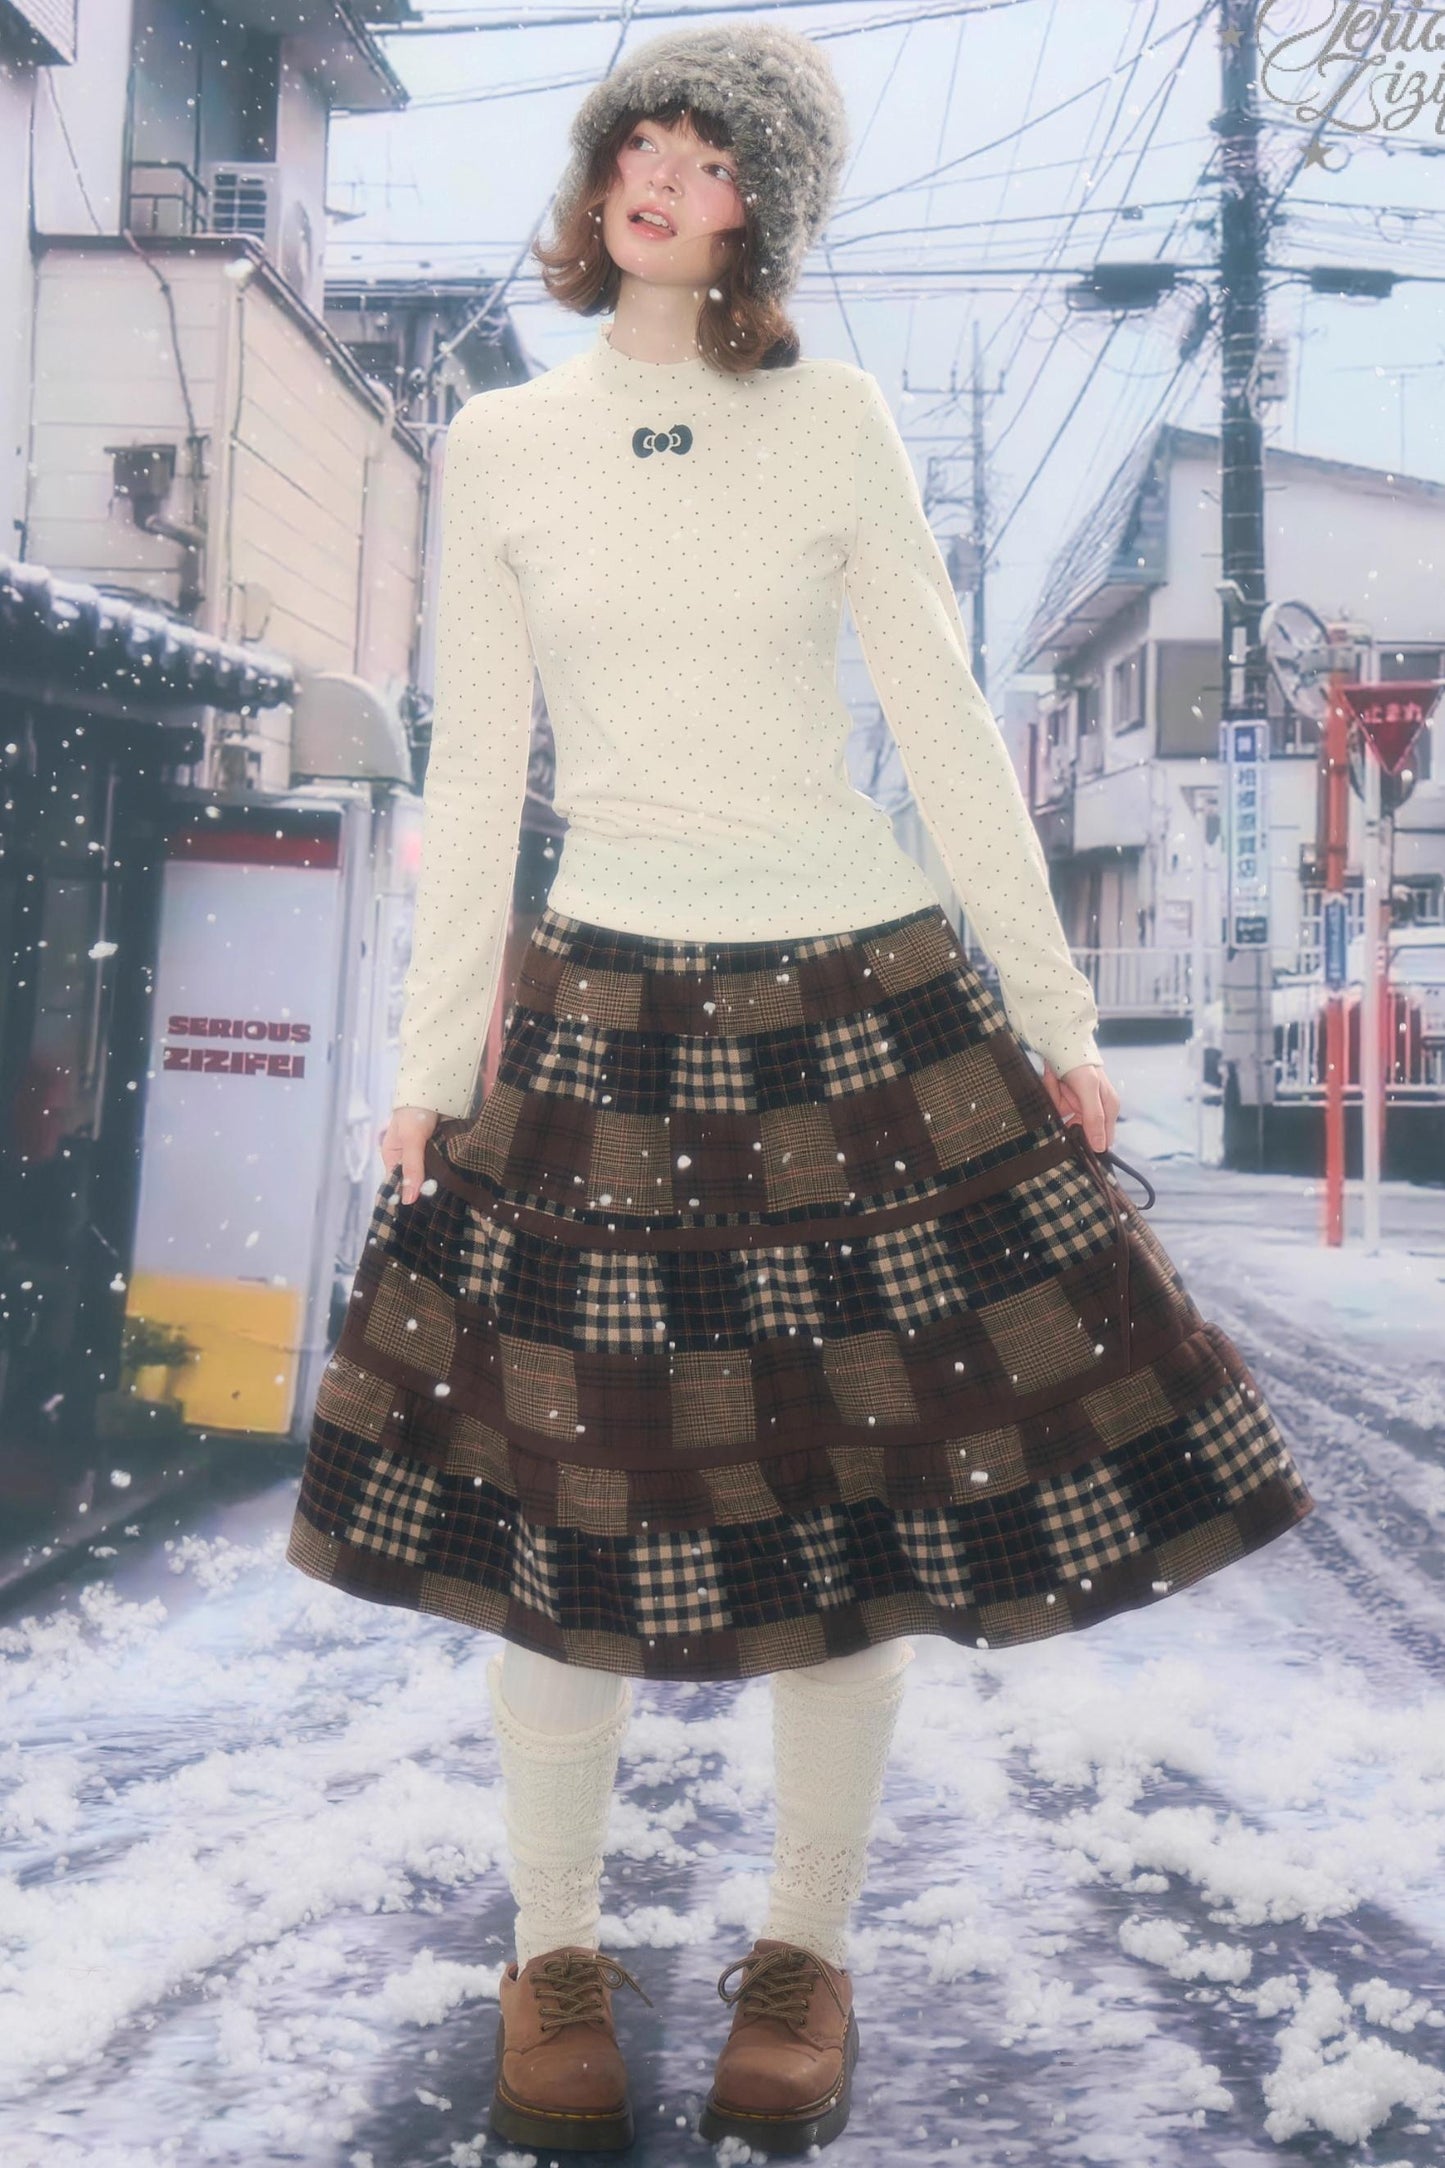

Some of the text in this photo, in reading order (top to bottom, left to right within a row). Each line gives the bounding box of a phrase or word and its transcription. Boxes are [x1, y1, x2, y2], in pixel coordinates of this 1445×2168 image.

[1364, 701, 1423, 724] 止まれ
[168, 1015, 311, 1043] SERIOUS
